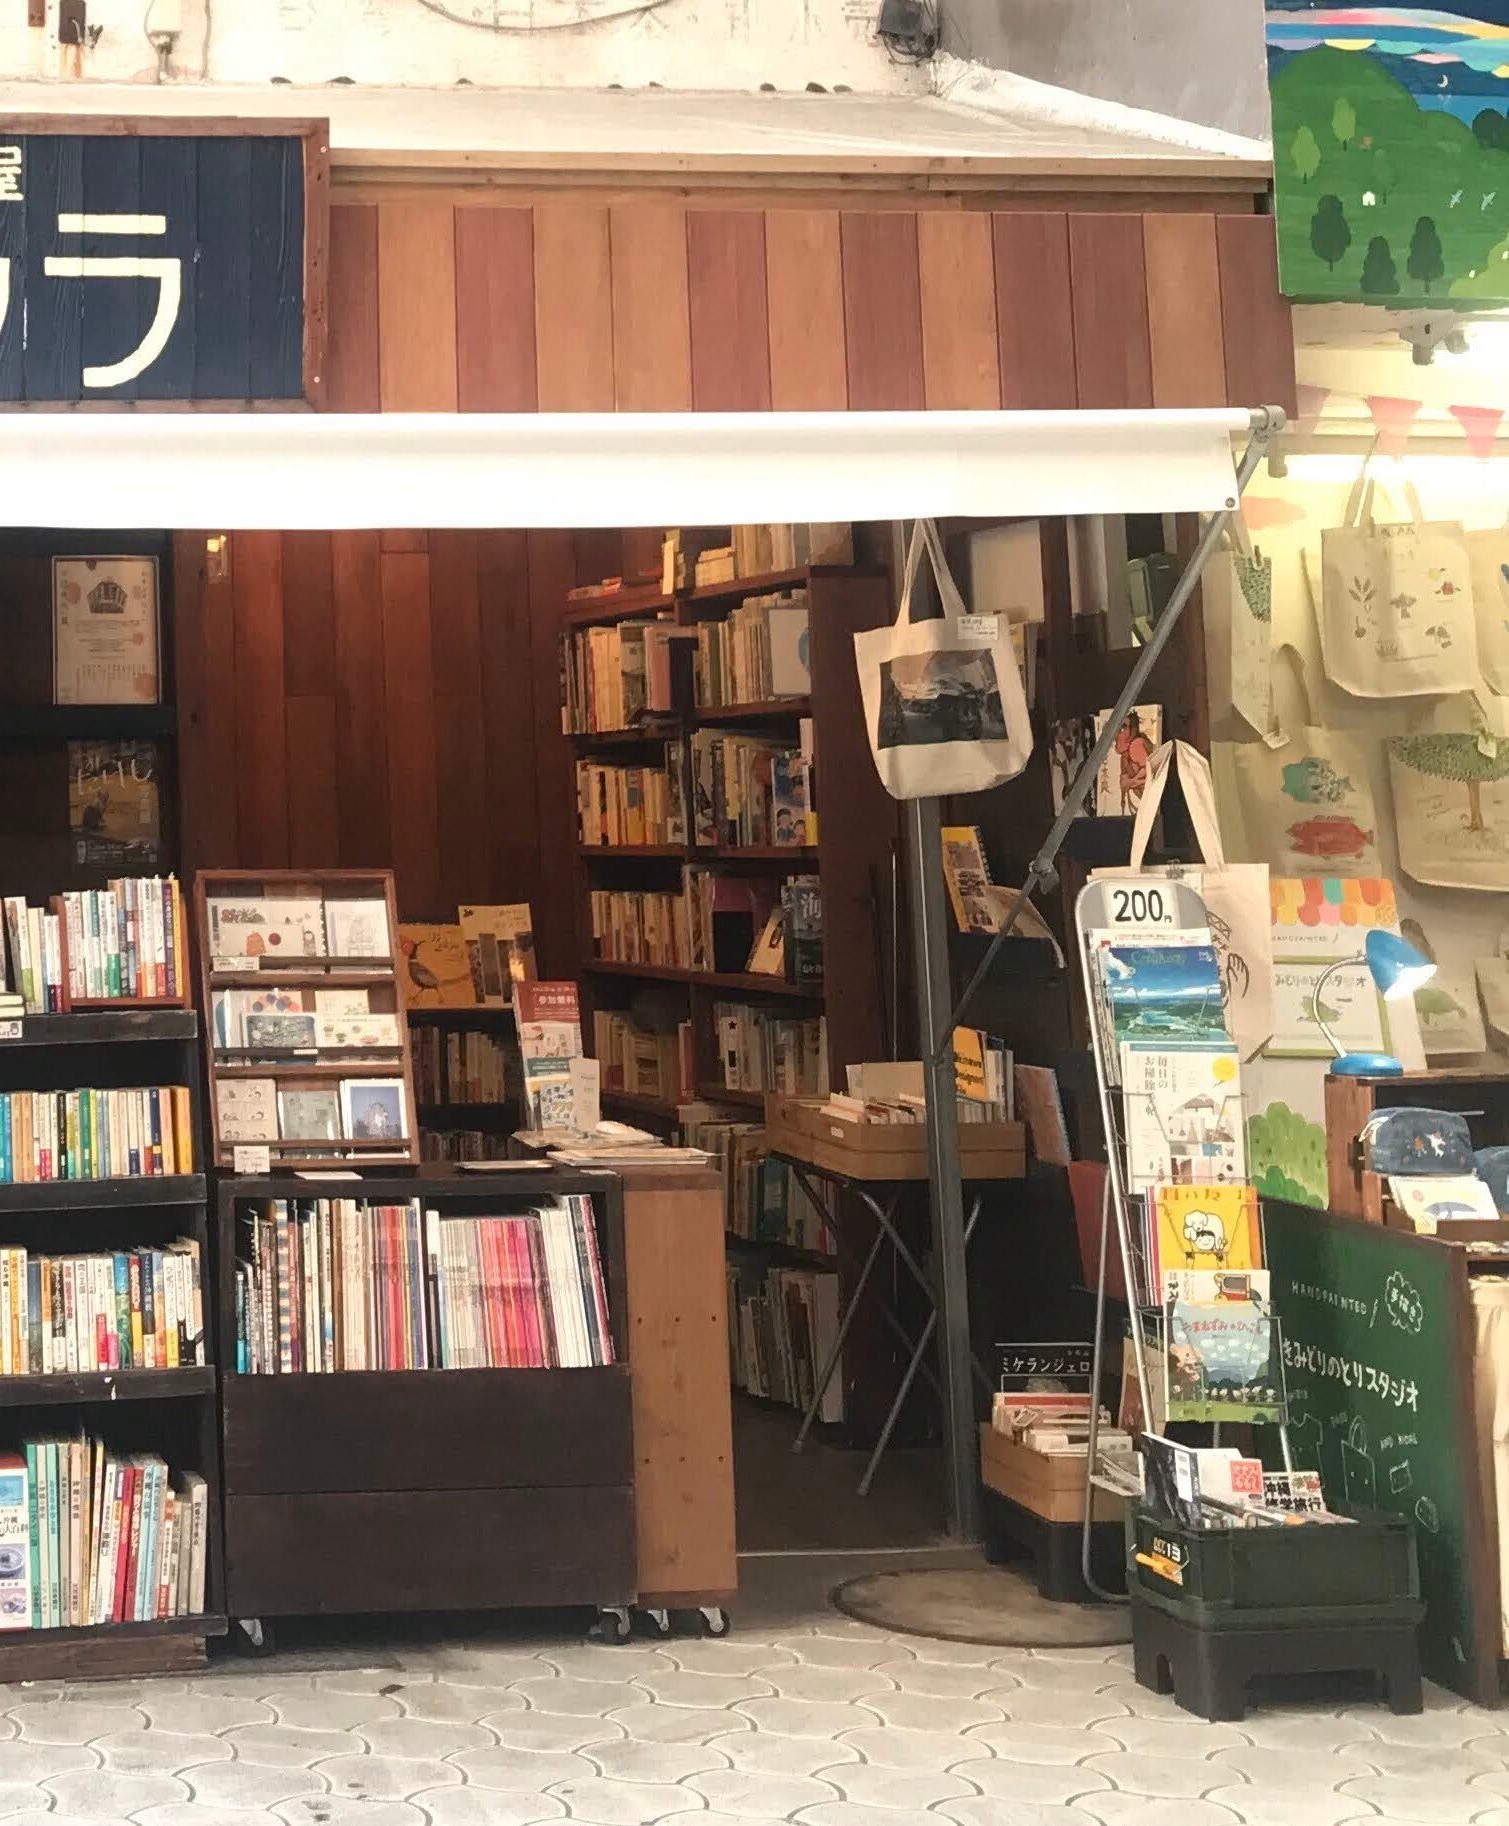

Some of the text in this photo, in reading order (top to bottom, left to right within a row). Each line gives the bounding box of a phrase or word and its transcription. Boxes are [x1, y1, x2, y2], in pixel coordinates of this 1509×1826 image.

[1112, 889, 1173, 924] 200円
[1291, 1280, 1367, 1316] HANDPAINTED
[1002, 1357, 1090, 1373] ミケランジェロ
[1282, 1337, 1420, 1413] きみどりのとりスタジオ
